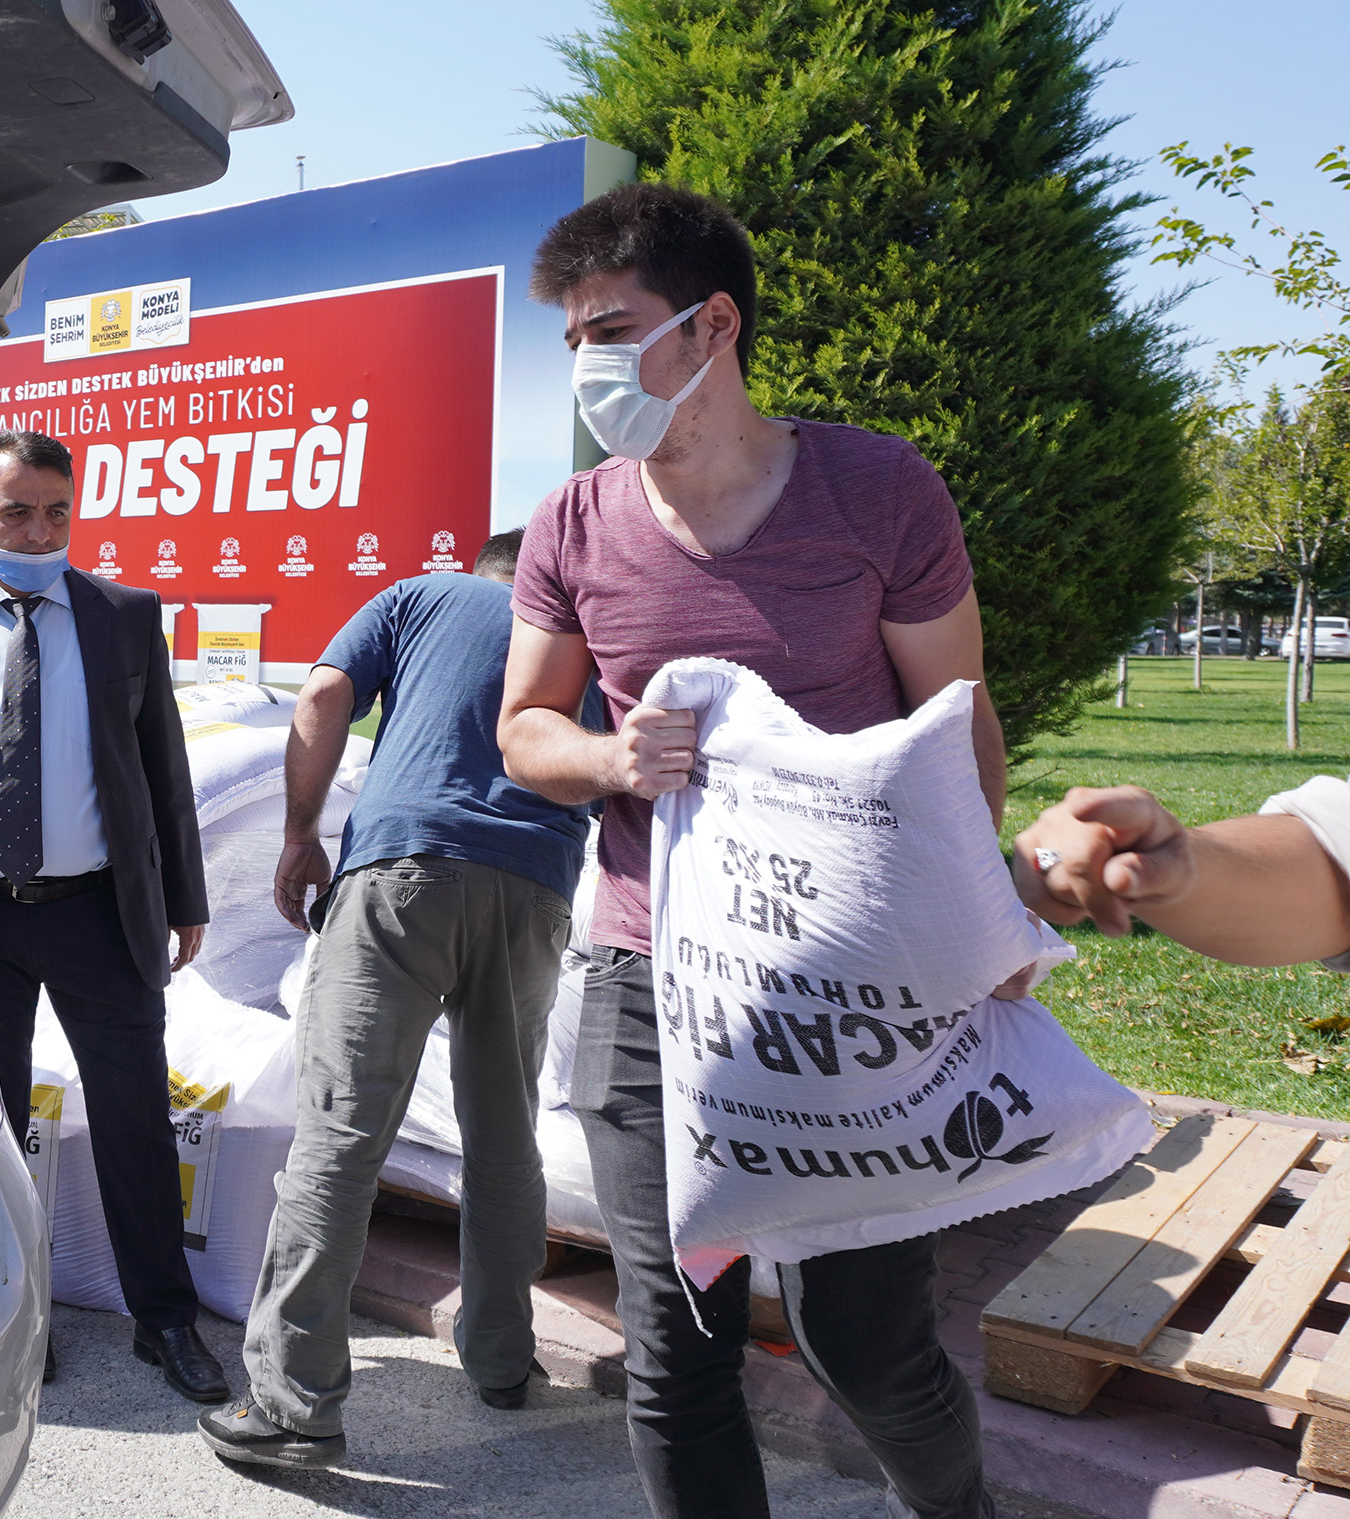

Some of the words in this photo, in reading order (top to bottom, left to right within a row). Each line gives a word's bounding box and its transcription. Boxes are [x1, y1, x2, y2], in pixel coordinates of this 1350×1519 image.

[142, 290, 179, 309] KONYA
[101, 324, 119, 332] KONYA
[15, 380, 67, 402] SİZDEN
[71, 371, 132, 394] DESTEK
[123, 395, 176, 430] YEM
[79, 399, 369, 520] DESTEĞİ
[432, 554, 453, 562] KONYA
[207, 656, 233, 665] MACAR
[769, 853, 818, 900] 25
[727, 884, 801, 941] NET
[908, 1023, 983, 1108] Maksimum
[674, 1076, 719, 1112] verim
[723, 1098, 833, 1130] maksimum
[839, 1103, 908, 1130] kalite
